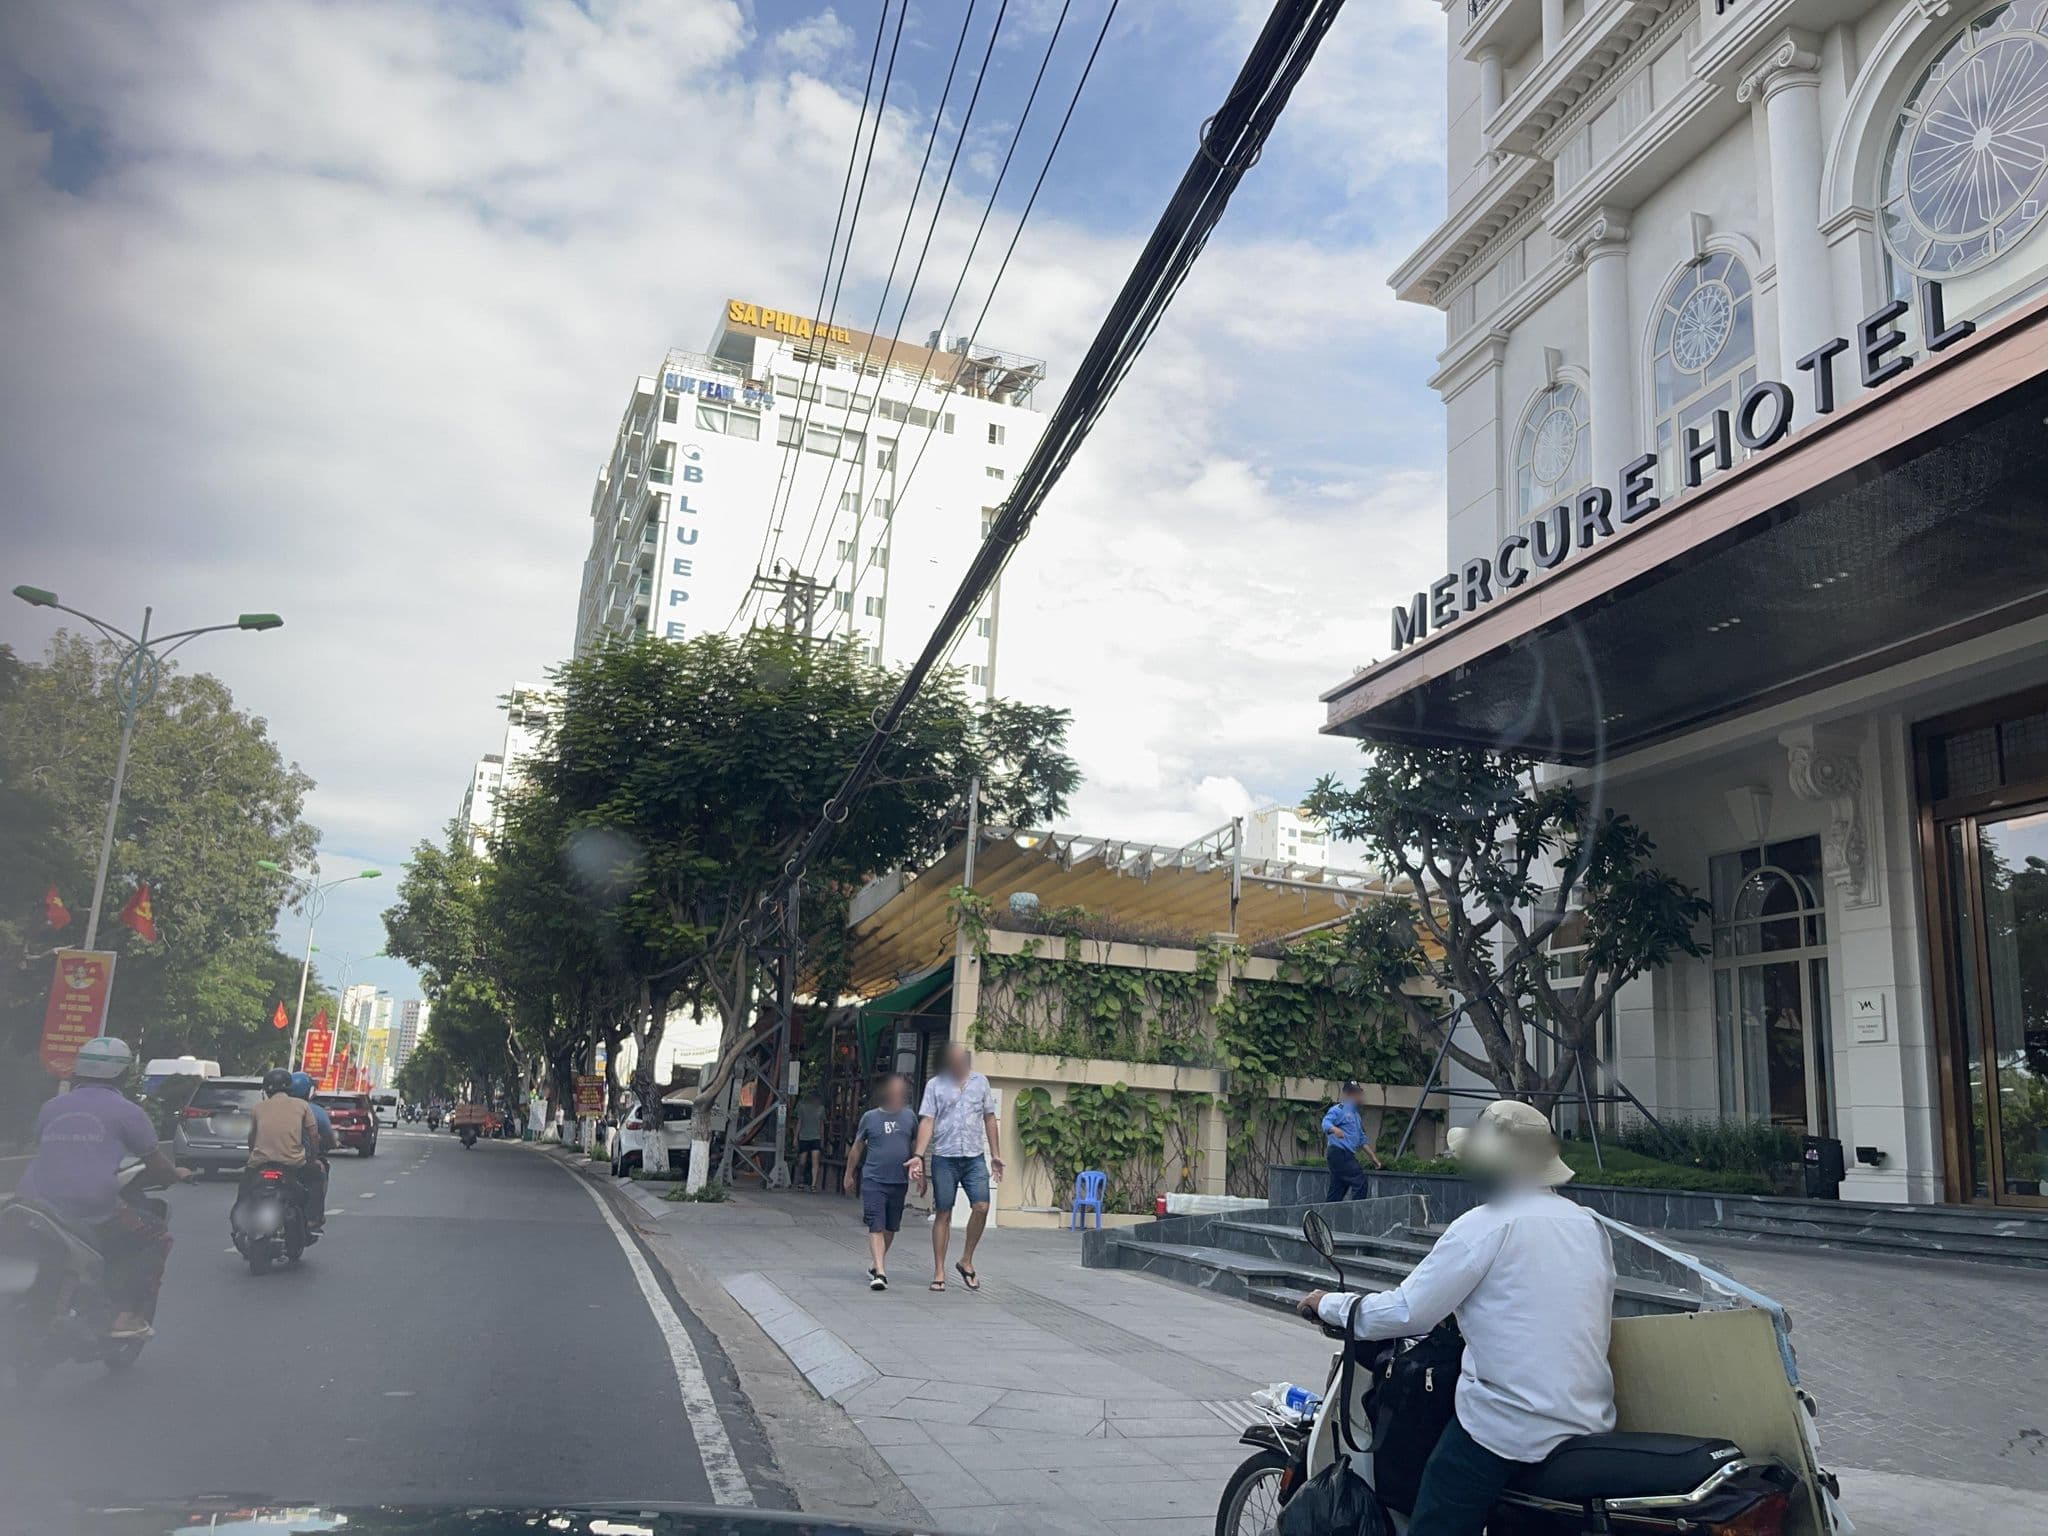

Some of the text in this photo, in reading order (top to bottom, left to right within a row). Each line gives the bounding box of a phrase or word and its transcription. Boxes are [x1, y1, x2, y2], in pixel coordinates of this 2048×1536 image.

[729, 300, 851, 344] SA PHIA HOTEL
[665, 373, 697, 394] BLUE
[698, 380, 733, 401] PEARL
[1391, 280, 1976, 651] MERCURE HOTEL
